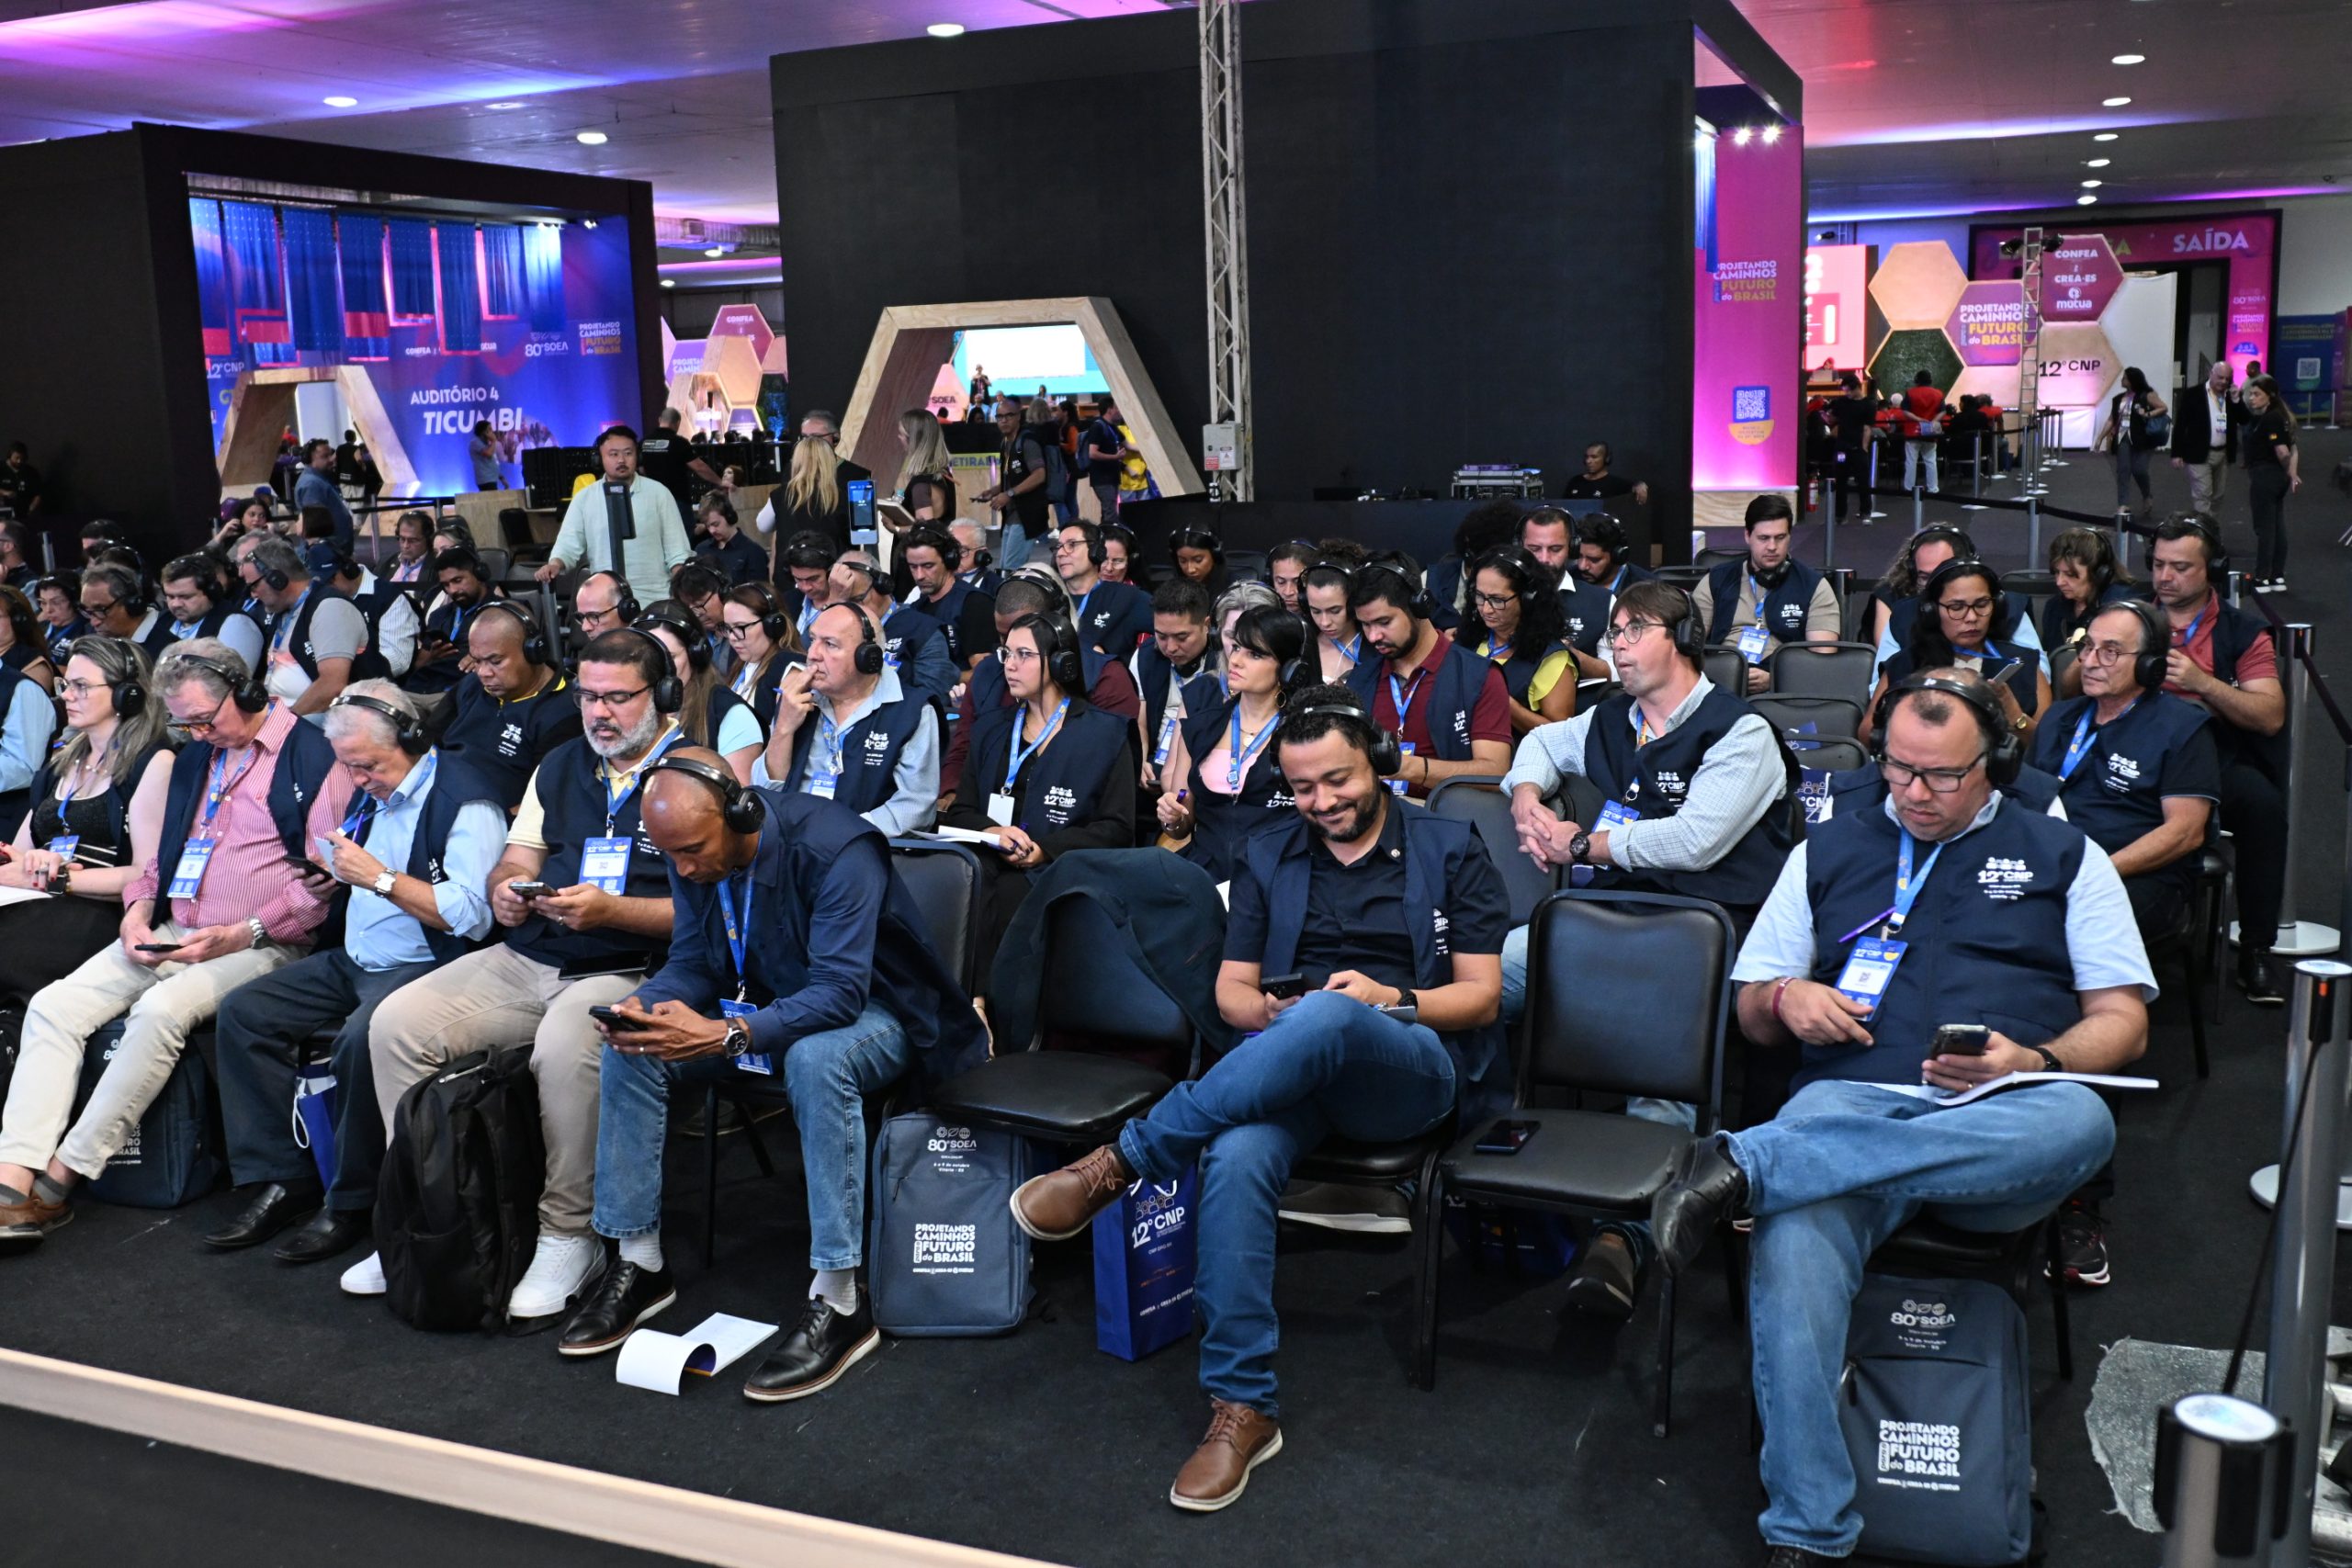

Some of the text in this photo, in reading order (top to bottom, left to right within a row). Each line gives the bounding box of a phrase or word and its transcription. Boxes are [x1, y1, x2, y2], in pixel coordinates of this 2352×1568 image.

[2174, 228, 2248, 253] SAÍDA
[2055, 249, 2098, 259] CONFEA
[1713, 268, 1777, 280] CAMINHOS
[1722, 278, 1777, 291] FUTURO
[1734, 290, 1777, 301] BRASIL
[579, 328, 621, 338] CAMINHOS
[1969, 336, 1980, 344] do
[405, 346, 431, 355] CONFEA
[224, 362, 244, 373] CNP
[2068, 360, 2101, 371] CNP
[410, 386, 499, 405] AUDITÓRIO 4
[932, 396, 956, 404] SOEA
[424, 407, 522, 434] TICUMBI
[2003, 870, 2034, 880] CNP
[950, 1140, 978, 1149] SOEA
[1154, 1206, 1185, 1230] CNP
[915, 1224, 976, 1233] PROJETANDO
[914, 1231, 976, 1242] CAMINHOS
[922, 1241, 976, 1253] FUTURO
[922, 1252, 975, 1263] do BRASIL
[1919, 1314, 1955, 1326] SOEA
[1879, 1419, 1960, 1436] PROJETANDO
[1879, 1429, 1961, 1449] CAMINHOS
[1890, 1443, 1961, 1463] FUTURO
[1890, 1459, 1961, 1477] do BRASIL
